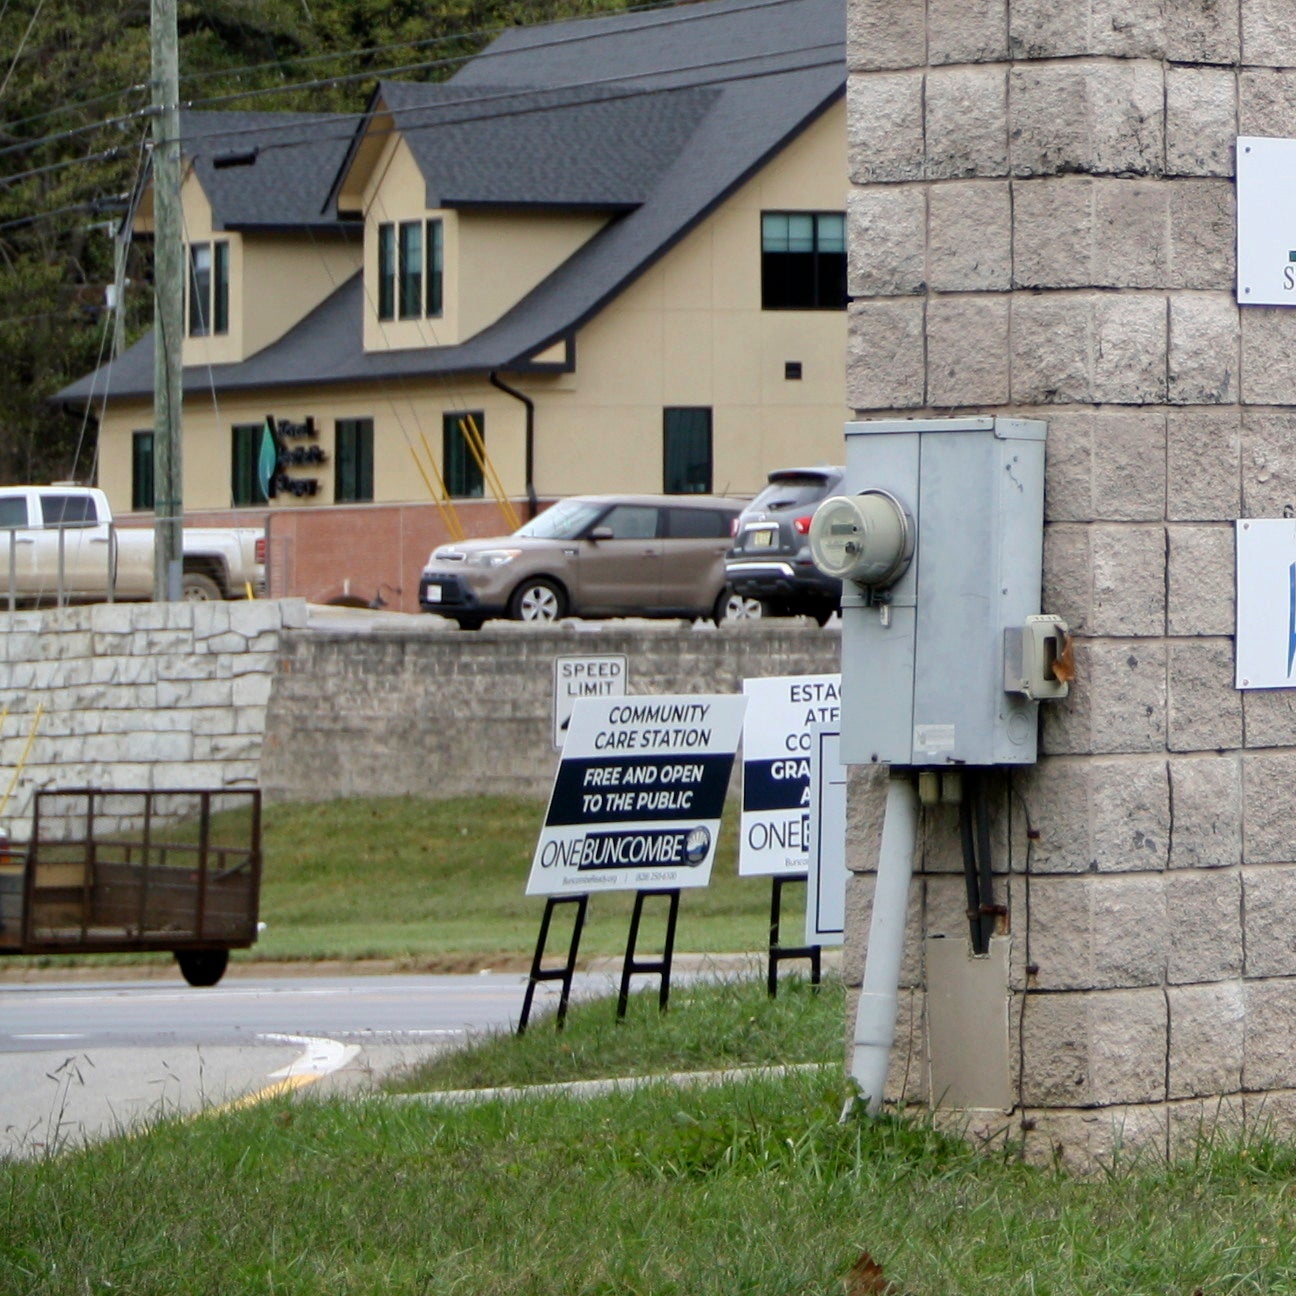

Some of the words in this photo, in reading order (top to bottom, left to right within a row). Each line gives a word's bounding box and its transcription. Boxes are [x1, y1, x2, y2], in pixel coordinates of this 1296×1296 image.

[562, 662, 621, 678] SPEED
[567, 681, 614, 696] LIMIT
[609, 704, 711, 725] COMMUNITY
[594, 730, 638, 750] CARE
[640, 729, 712, 748] STATION
[583, 766, 622, 787] FREE
[622, 766, 657, 785] AND
[660, 764, 704, 783] OPEN
[582, 794, 602, 813] TO
[606, 793, 635, 811] THE
[637, 790, 694, 810] PUBLIC
